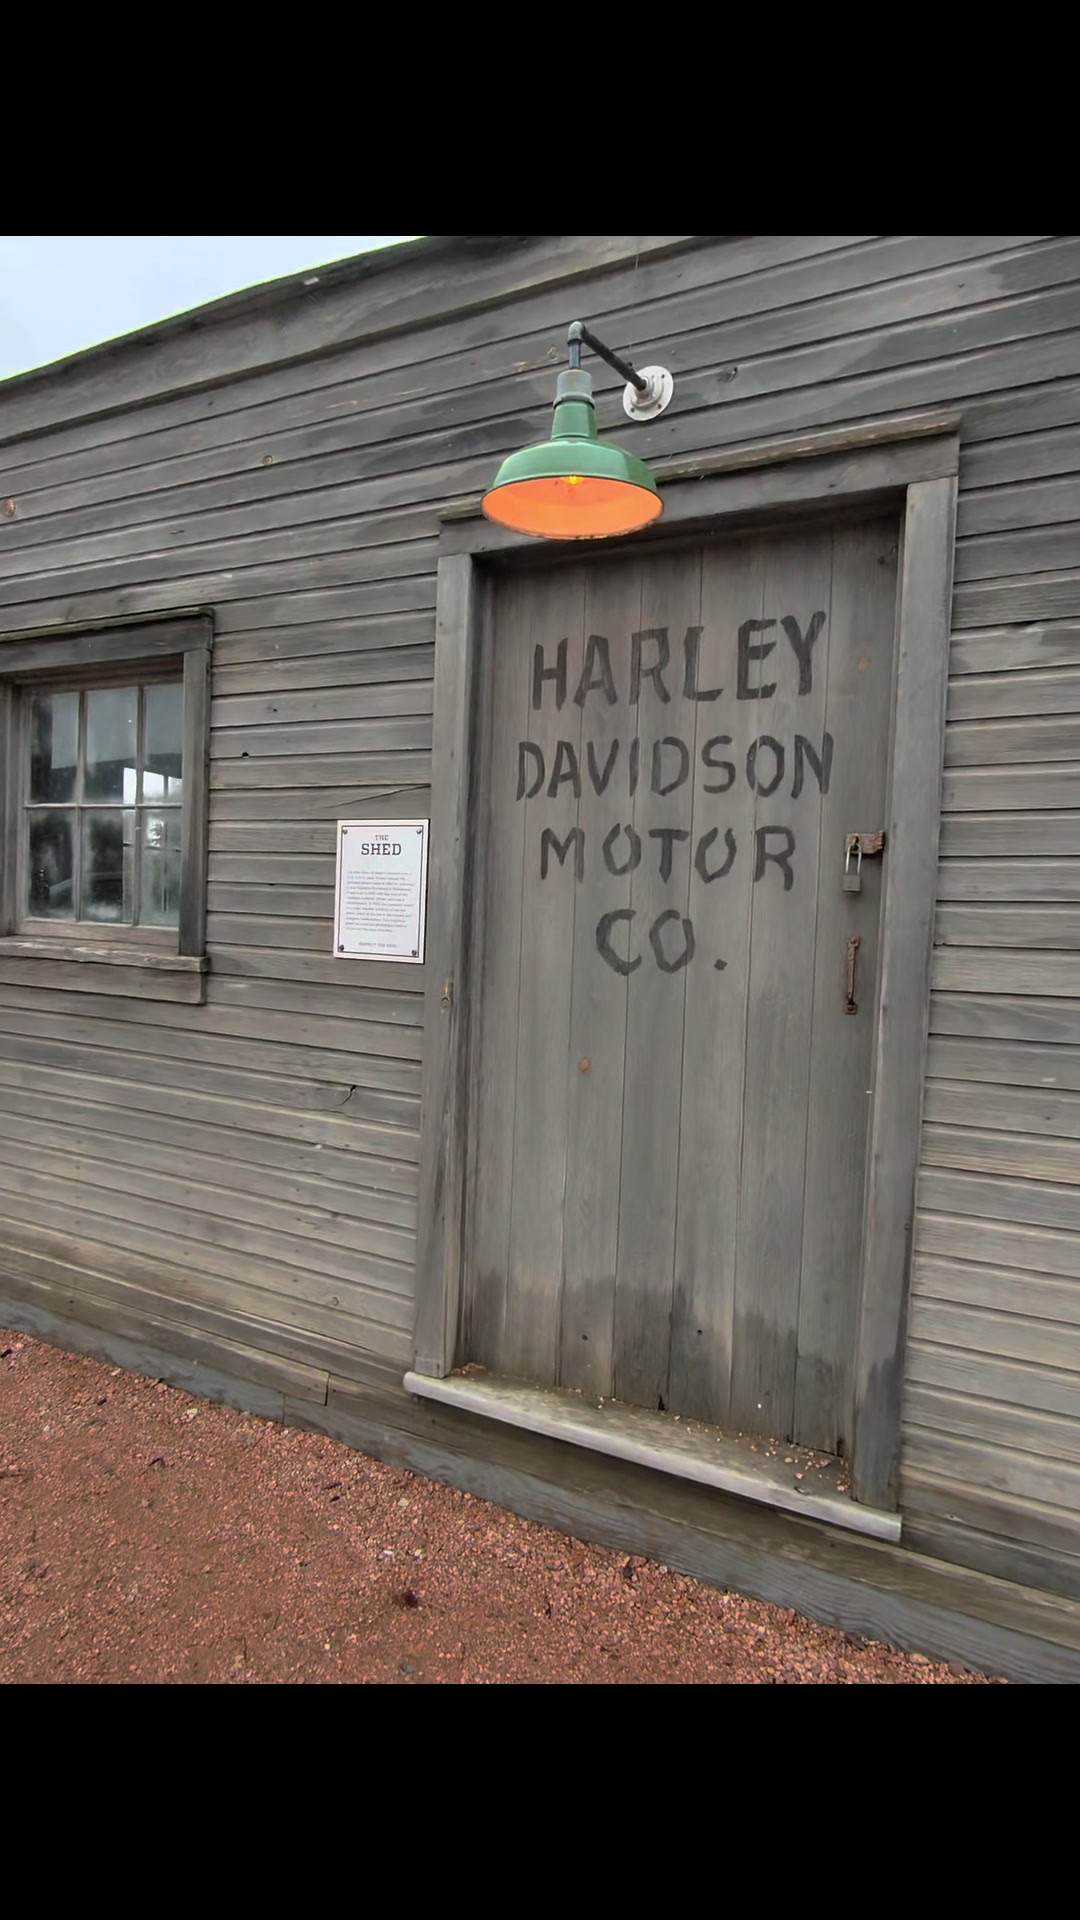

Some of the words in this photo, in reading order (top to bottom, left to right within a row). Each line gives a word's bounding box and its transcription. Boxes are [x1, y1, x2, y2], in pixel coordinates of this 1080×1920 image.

[533, 611, 827, 712] HARLEY
[516, 731, 834, 801] DAVIDSON
[361, 843, 402, 855] SHED
[541, 823, 796, 891] MOTOR
[596, 909, 728, 976] CO.
